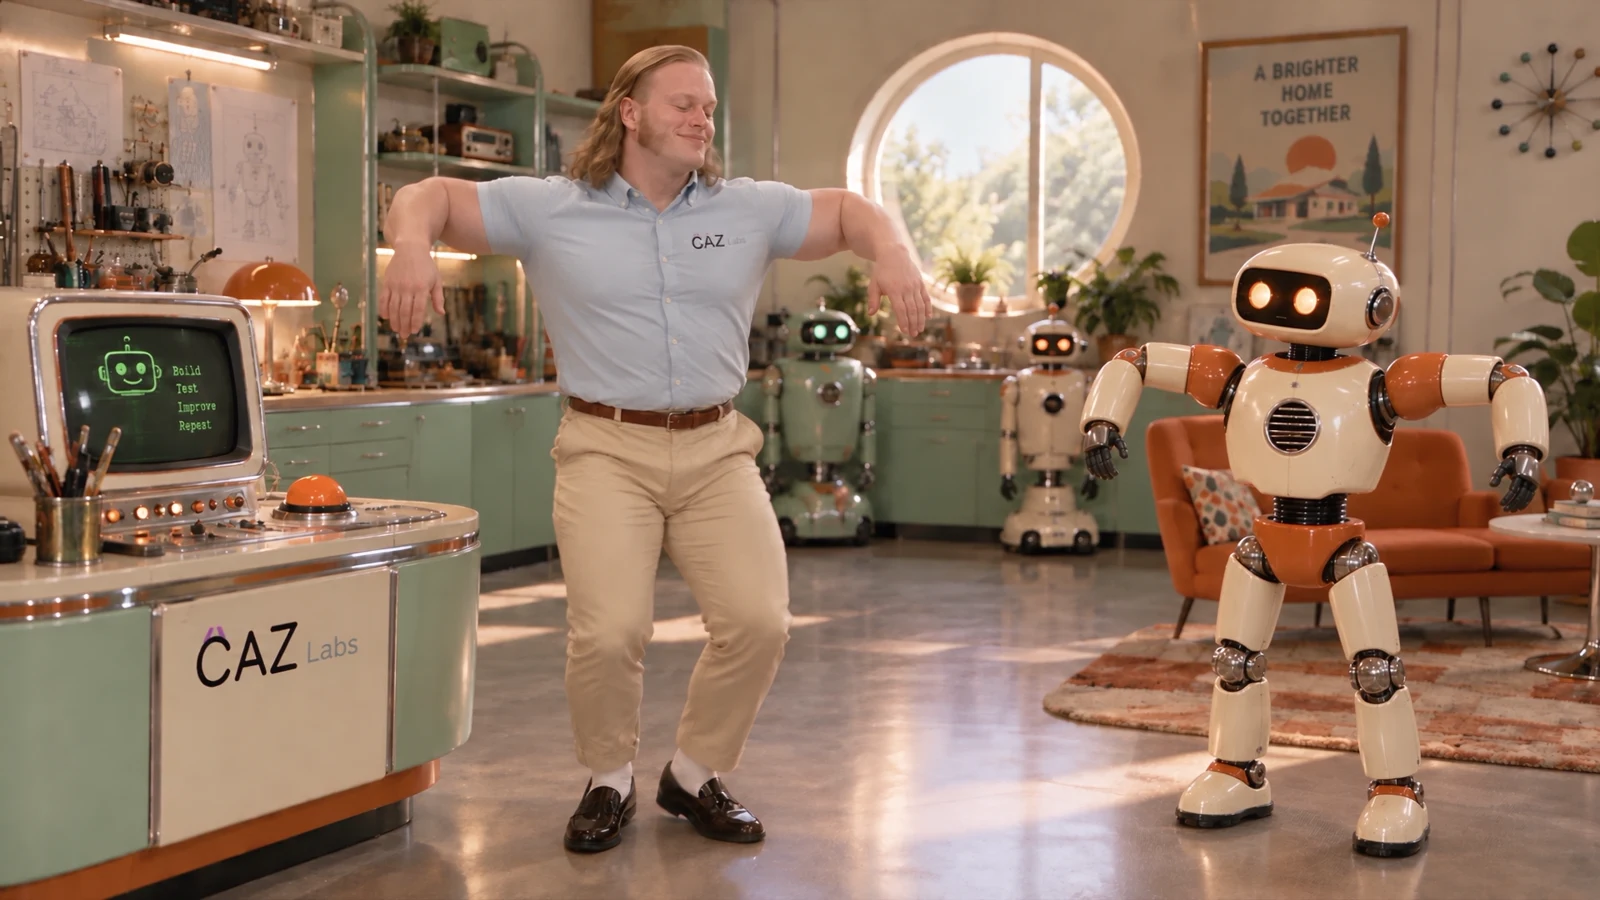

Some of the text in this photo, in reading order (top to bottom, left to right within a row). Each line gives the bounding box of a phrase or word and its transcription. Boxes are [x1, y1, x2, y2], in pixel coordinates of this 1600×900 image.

[1254, 56, 1359, 81] A BRIGHTER
[1282, 82, 1333, 102] HOME
[1261, 104, 1351, 126] TOGETHER
[176, 383, 199, 394] Test
[177, 401, 217, 415] Improve
[179, 420, 212, 433] Repeat
[307, 635, 359, 664] Labs
